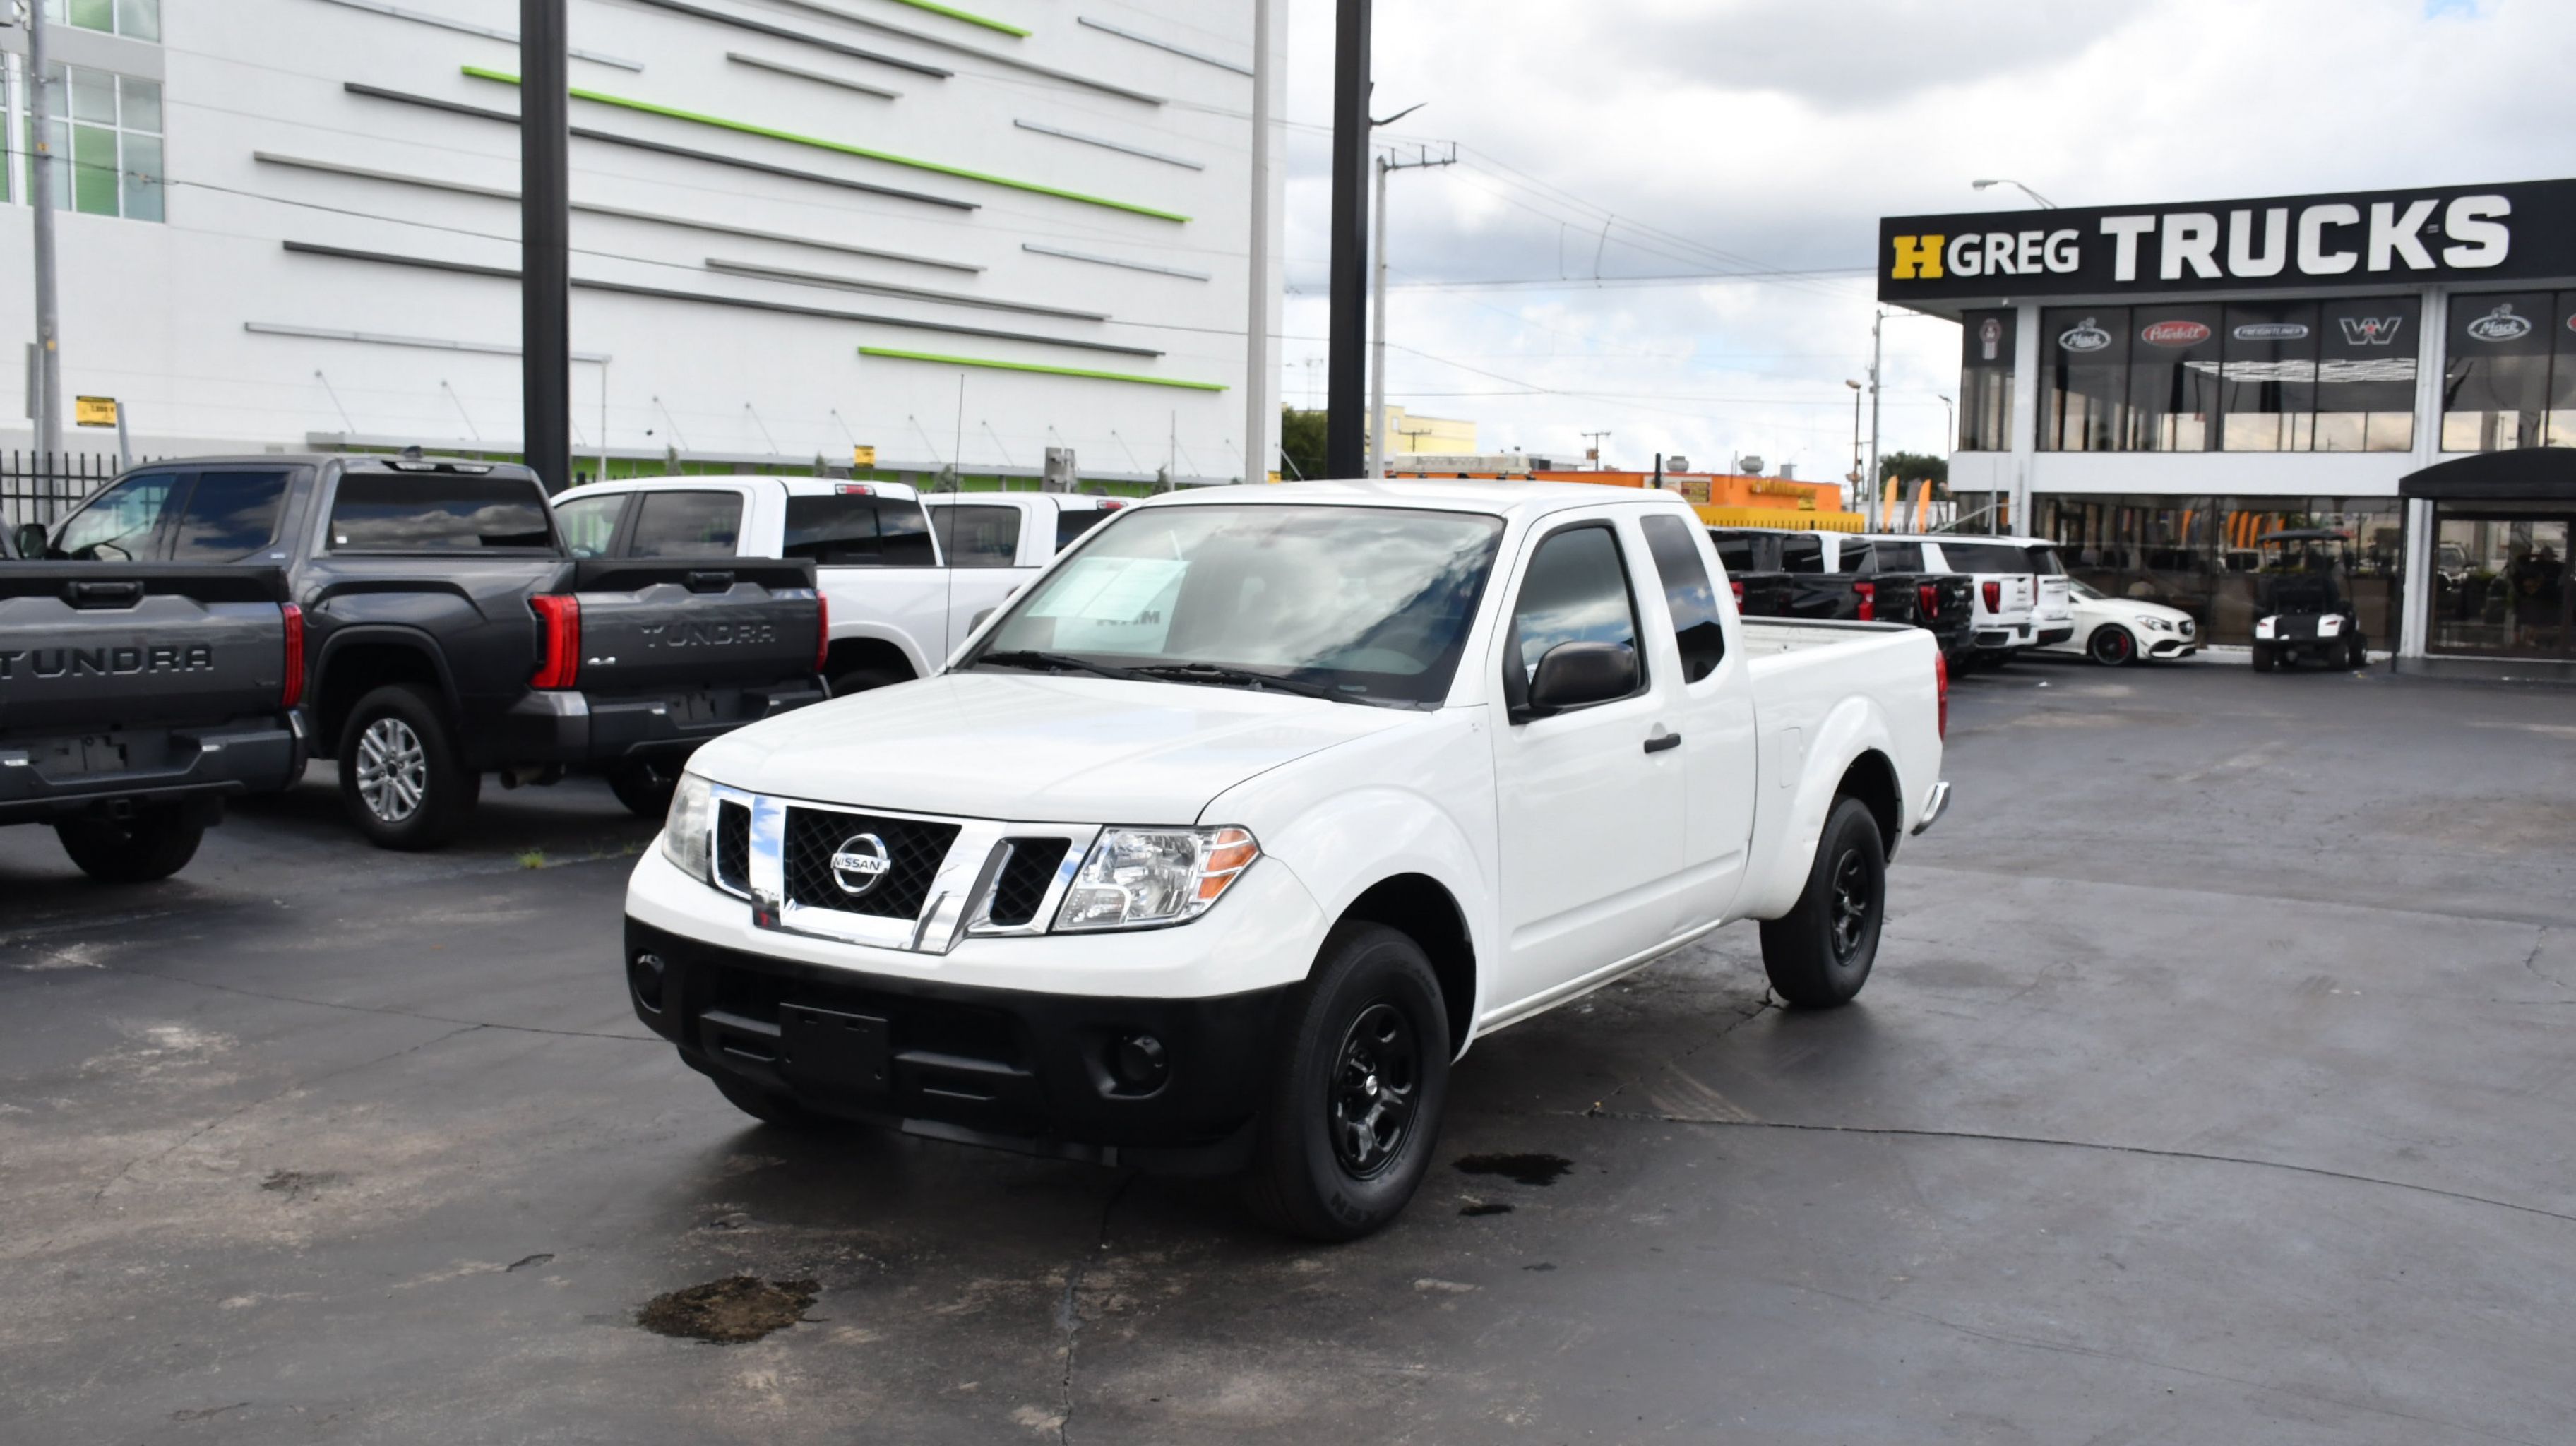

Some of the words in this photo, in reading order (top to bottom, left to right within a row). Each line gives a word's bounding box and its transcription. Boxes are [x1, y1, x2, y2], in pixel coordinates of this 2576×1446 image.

[2099, 195, 2511, 282] TRUCKS
[2478, 320, 2520, 337] Mack
[2067, 332, 2102, 348] Mack
[642, 624, 775, 648] TUNDRA
[0, 645, 214, 680] TUNDRA
[834, 856, 881, 871] NISSAN
